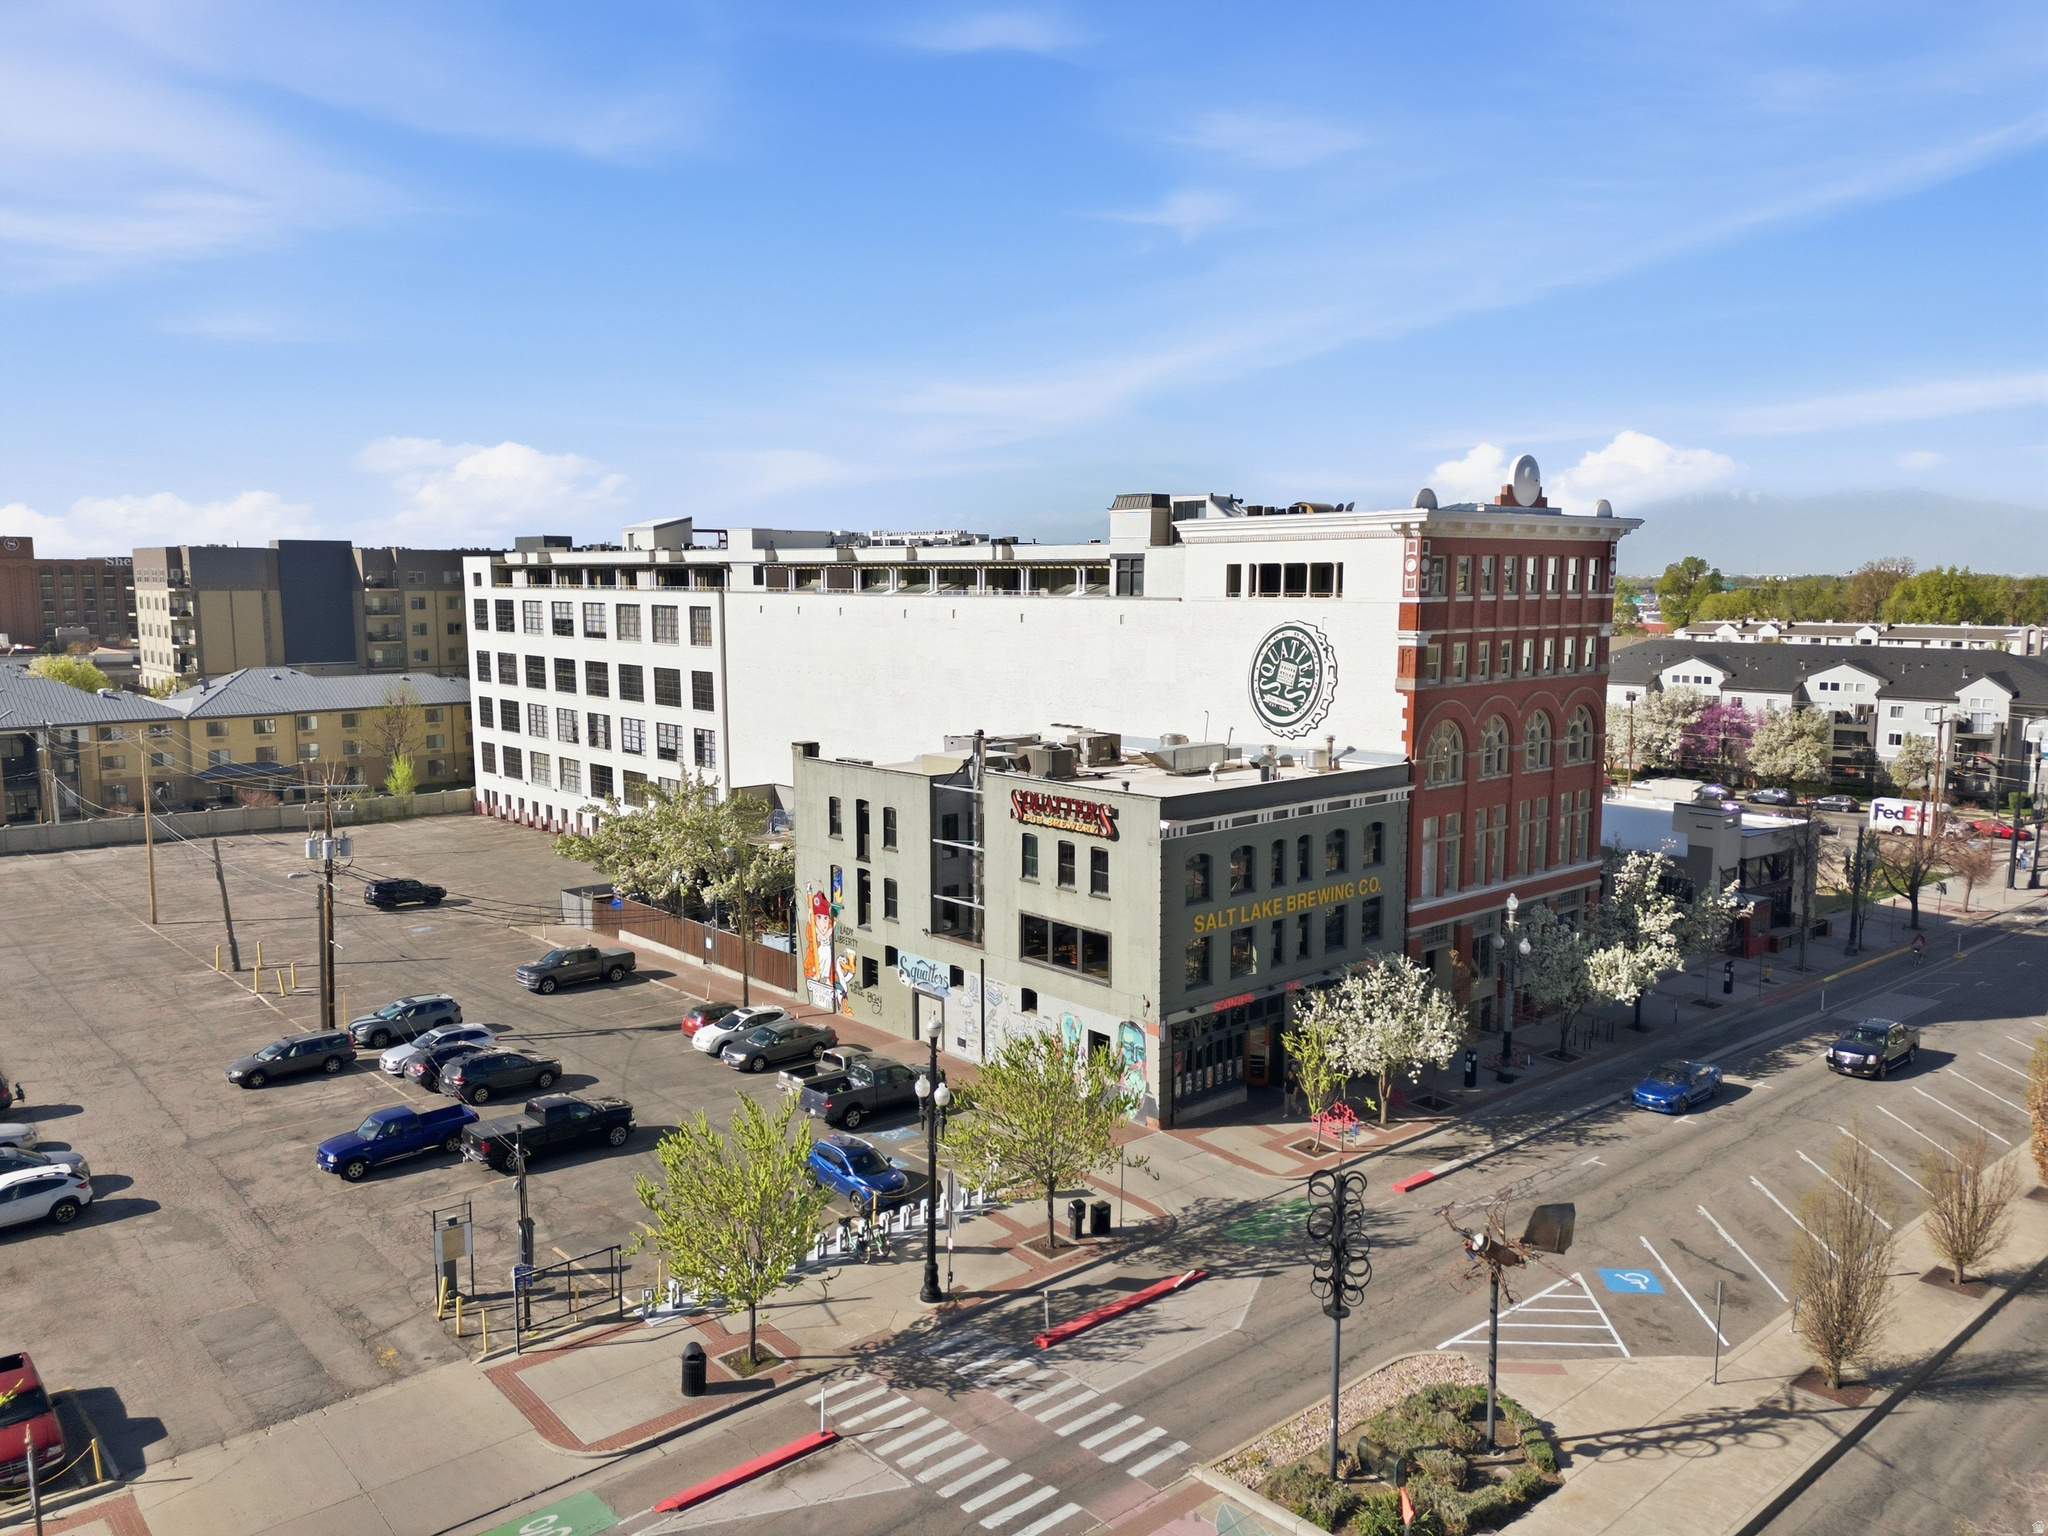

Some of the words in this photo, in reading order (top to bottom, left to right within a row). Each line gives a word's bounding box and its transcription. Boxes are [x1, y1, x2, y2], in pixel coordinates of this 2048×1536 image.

[105, 557, 133, 566] She
[1260, 640, 1315, 704] SQUATTERS
[1011, 789, 1113, 837] SQUATTERS
[1023, 813, 1043, 824] PUB
[1048, 817, 1099, 834] BREWERY
[1874, 803, 1929, 822] FedEx
[1194, 908, 1236, 933] SALT
[1240, 898, 1283, 923] LAKE
[1286, 882, 1355, 913] BREWING
[1358, 876, 1381, 896] CO.
[840, 926, 854, 937] LADY
[900, 955, 949, 990] Squatters
